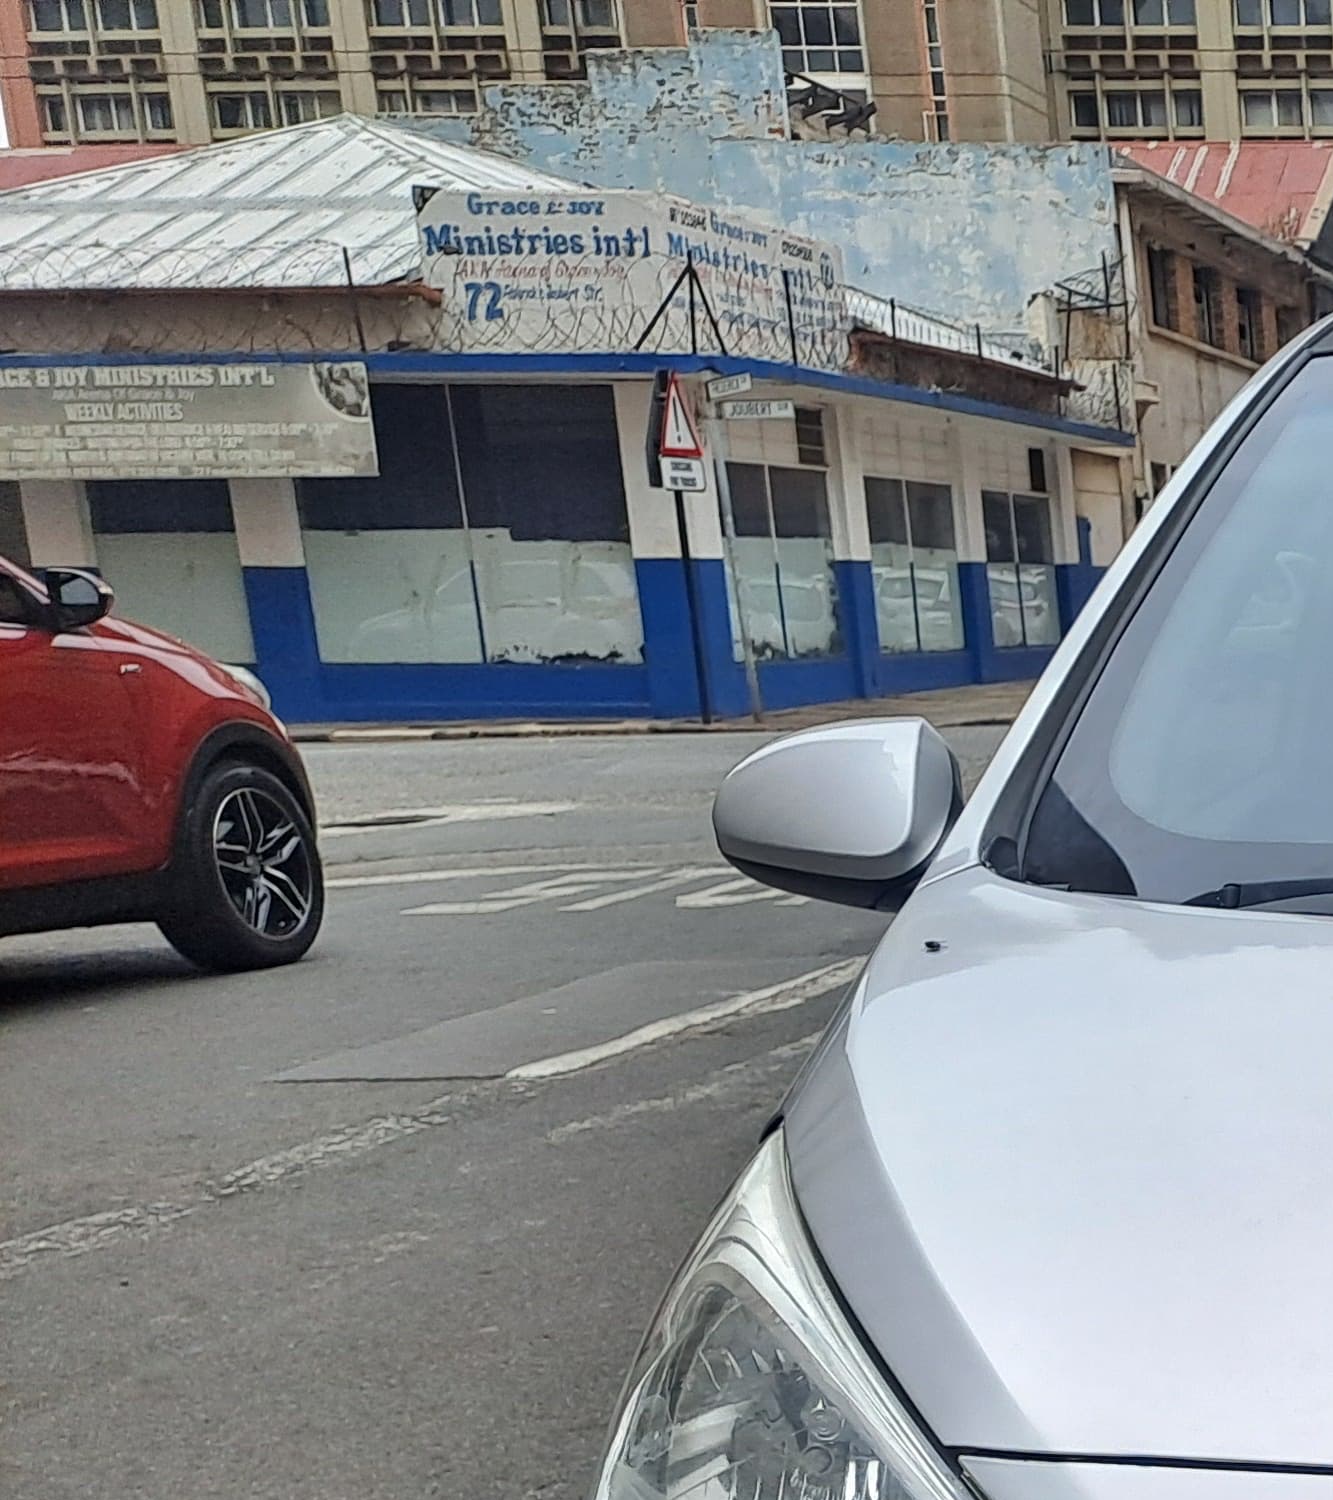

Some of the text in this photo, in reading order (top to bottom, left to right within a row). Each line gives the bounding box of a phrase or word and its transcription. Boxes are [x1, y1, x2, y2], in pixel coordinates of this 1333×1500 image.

[466, 192, 541, 215] Grace
[422, 223, 585, 256] Ministries
[464, 281, 505, 321] 72
[54, 366, 88, 387] JOY
[94, 365, 214, 387] MINISTRIES
[64, 401, 185, 422] WEEKLY ACTIVITIES
